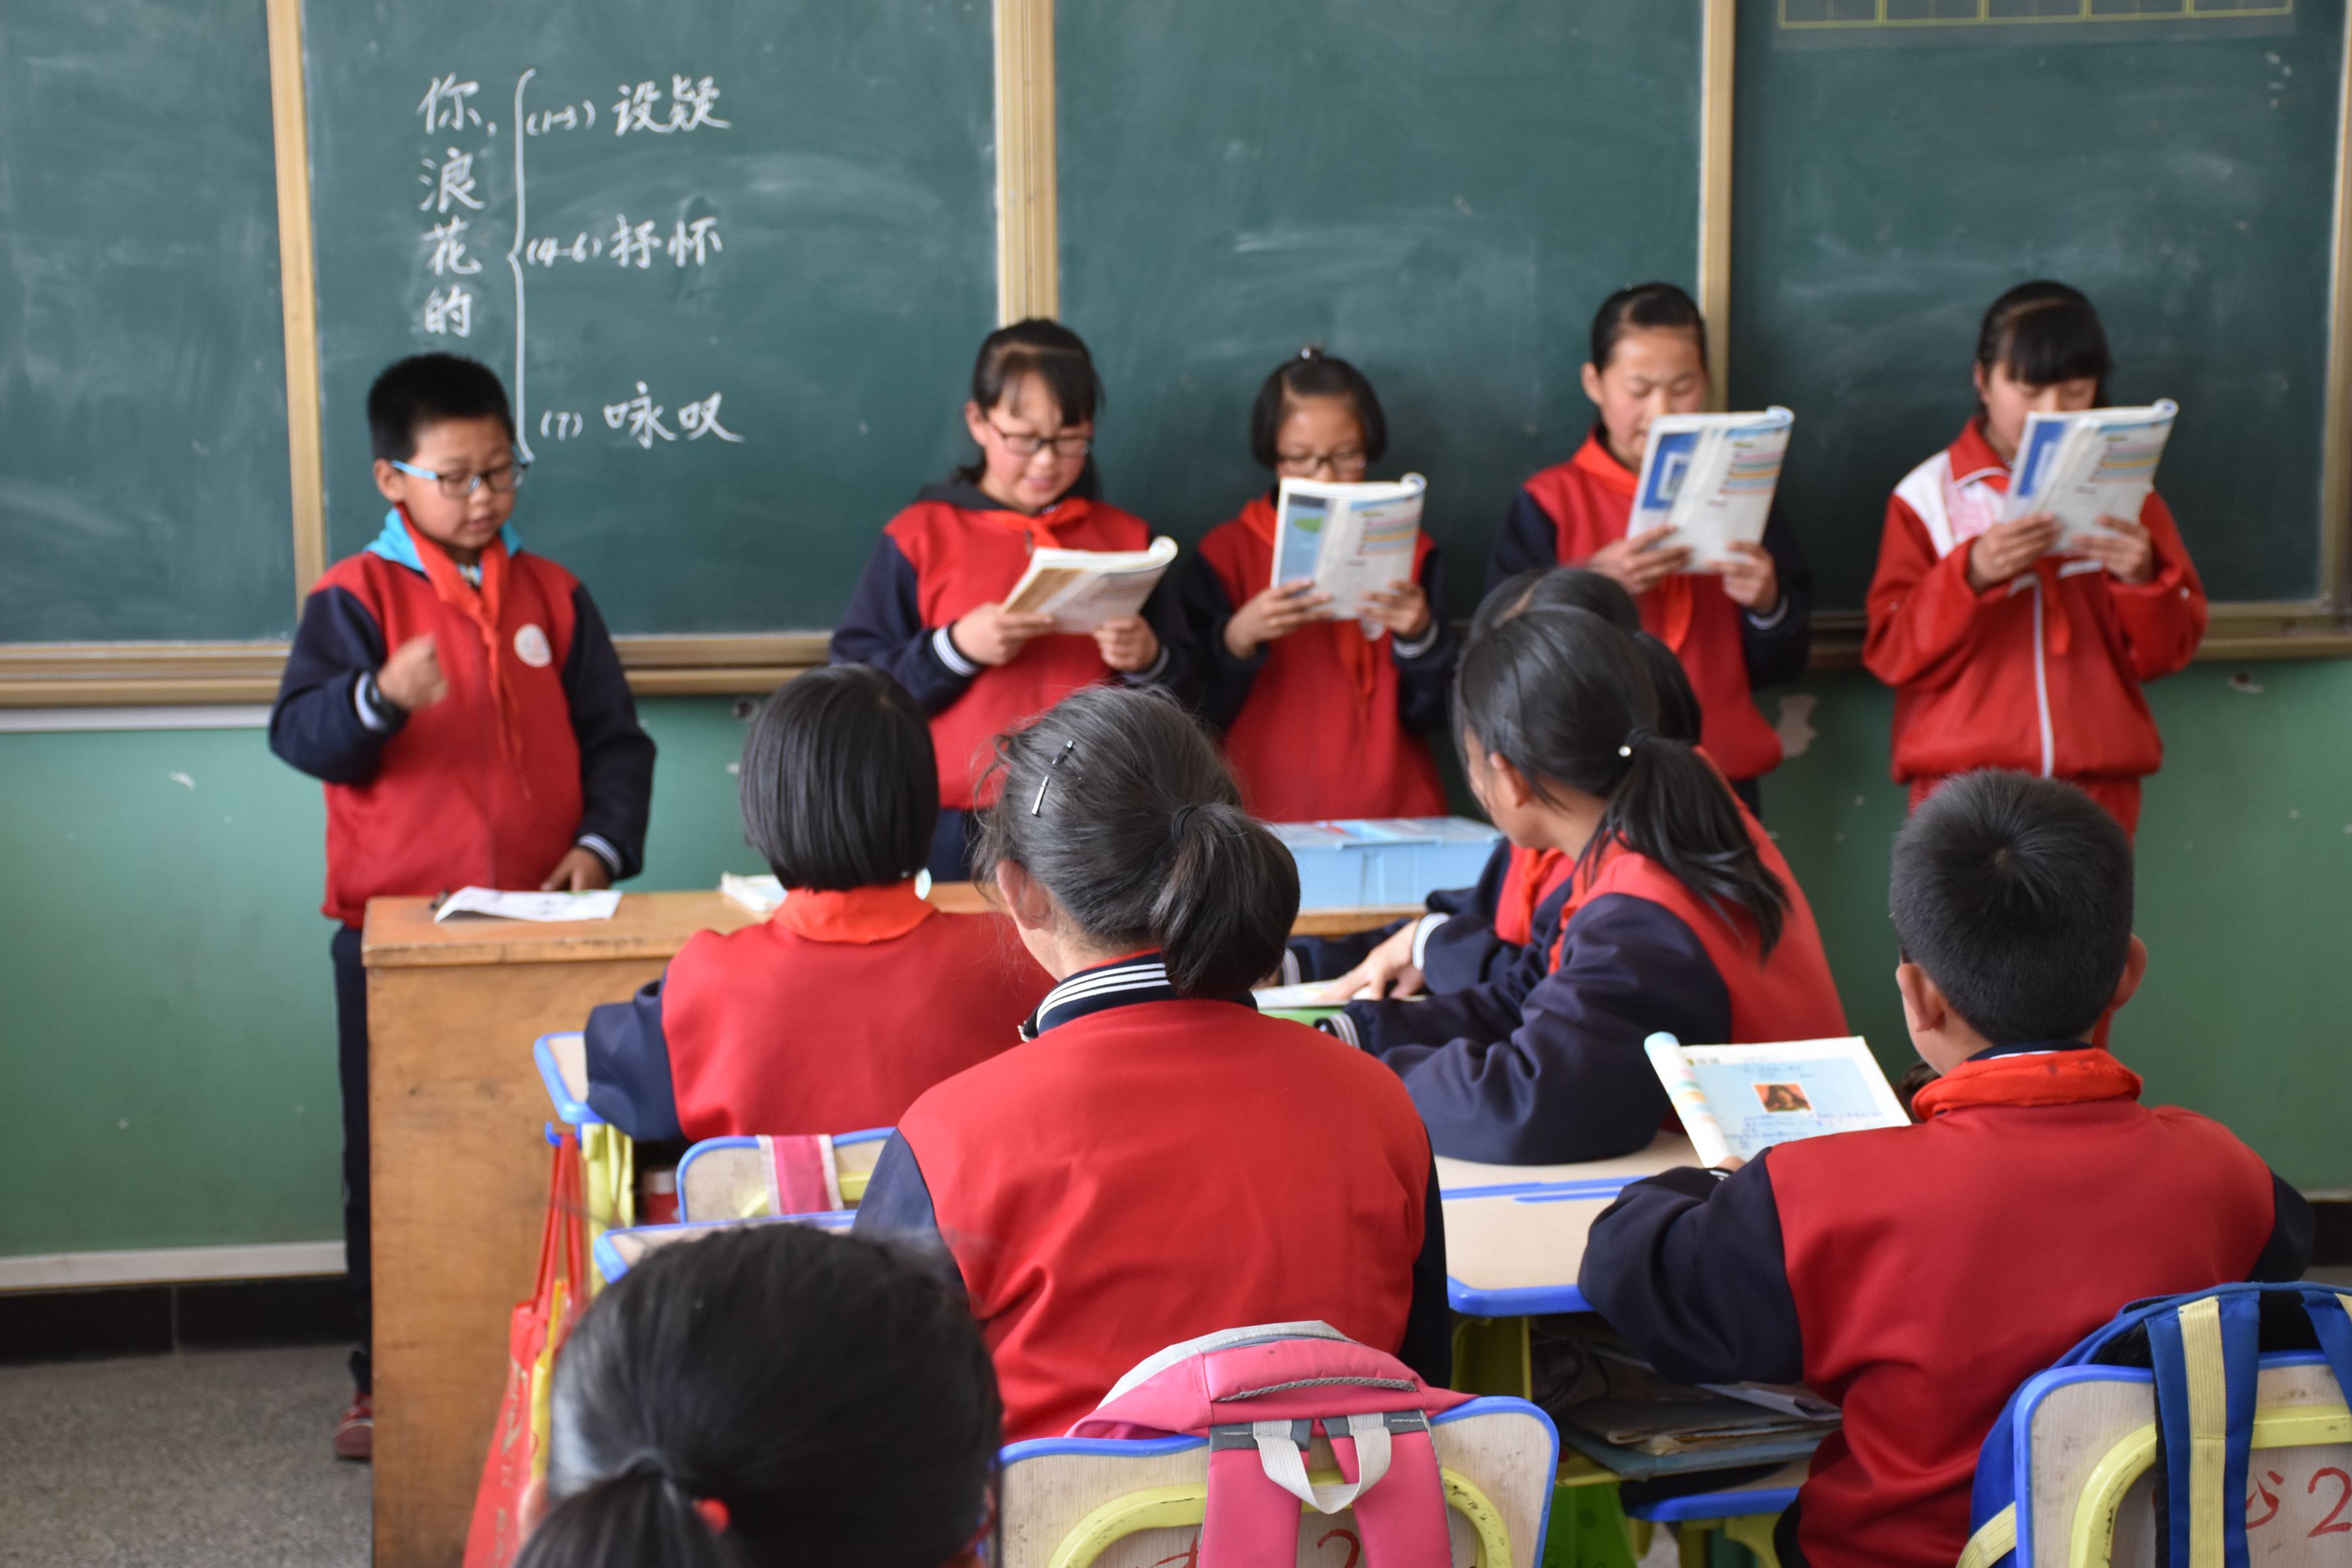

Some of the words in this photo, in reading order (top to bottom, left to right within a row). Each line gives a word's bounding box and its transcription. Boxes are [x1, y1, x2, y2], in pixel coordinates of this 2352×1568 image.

[611, 73, 732, 137] 设疑
[609, 212, 723, 270] 抒怀
[540, 409, 583, 440] (7)
[602, 380, 746, 449] 咏叹
